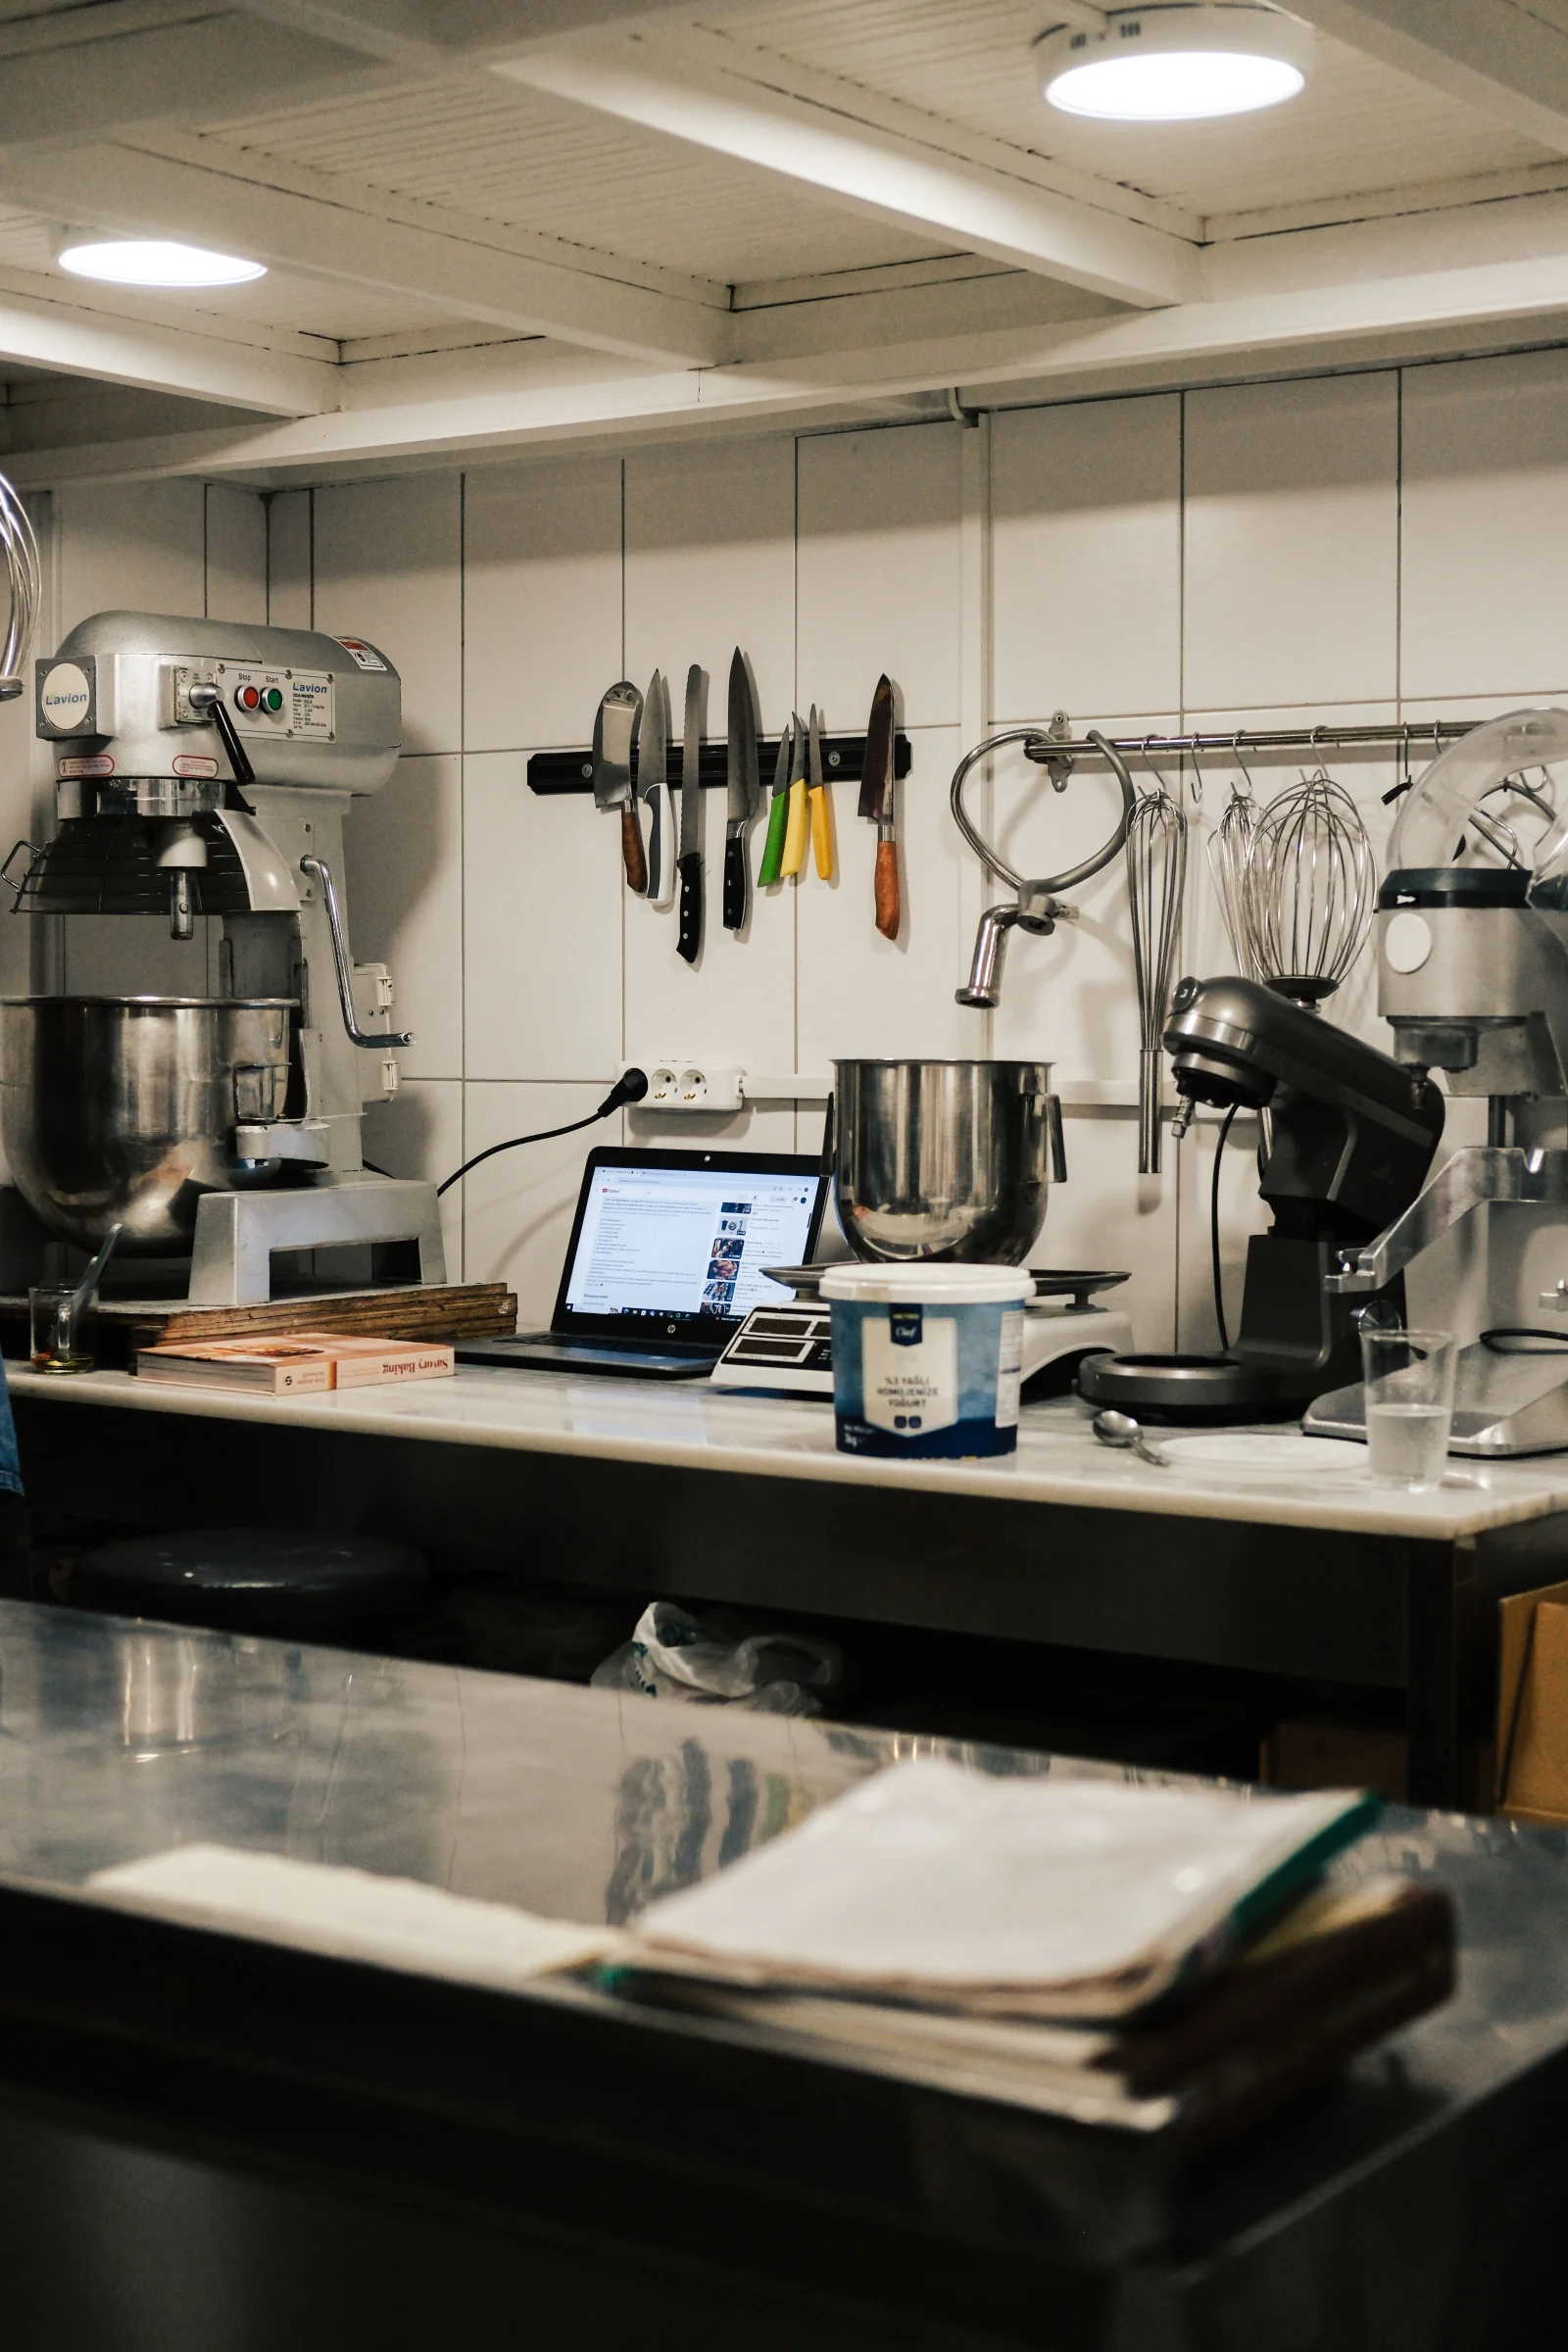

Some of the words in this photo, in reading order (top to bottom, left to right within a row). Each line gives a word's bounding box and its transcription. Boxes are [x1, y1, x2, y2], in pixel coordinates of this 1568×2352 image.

[238, 672, 252, 682] Stop
[265, 675, 279, 684] Start
[292, 682, 327, 694] Lavion
[45, 693, 87, 706] Lavion
[382, 1363, 416, 1375] Baking
[417, 1358, 449, 1371] Savory
